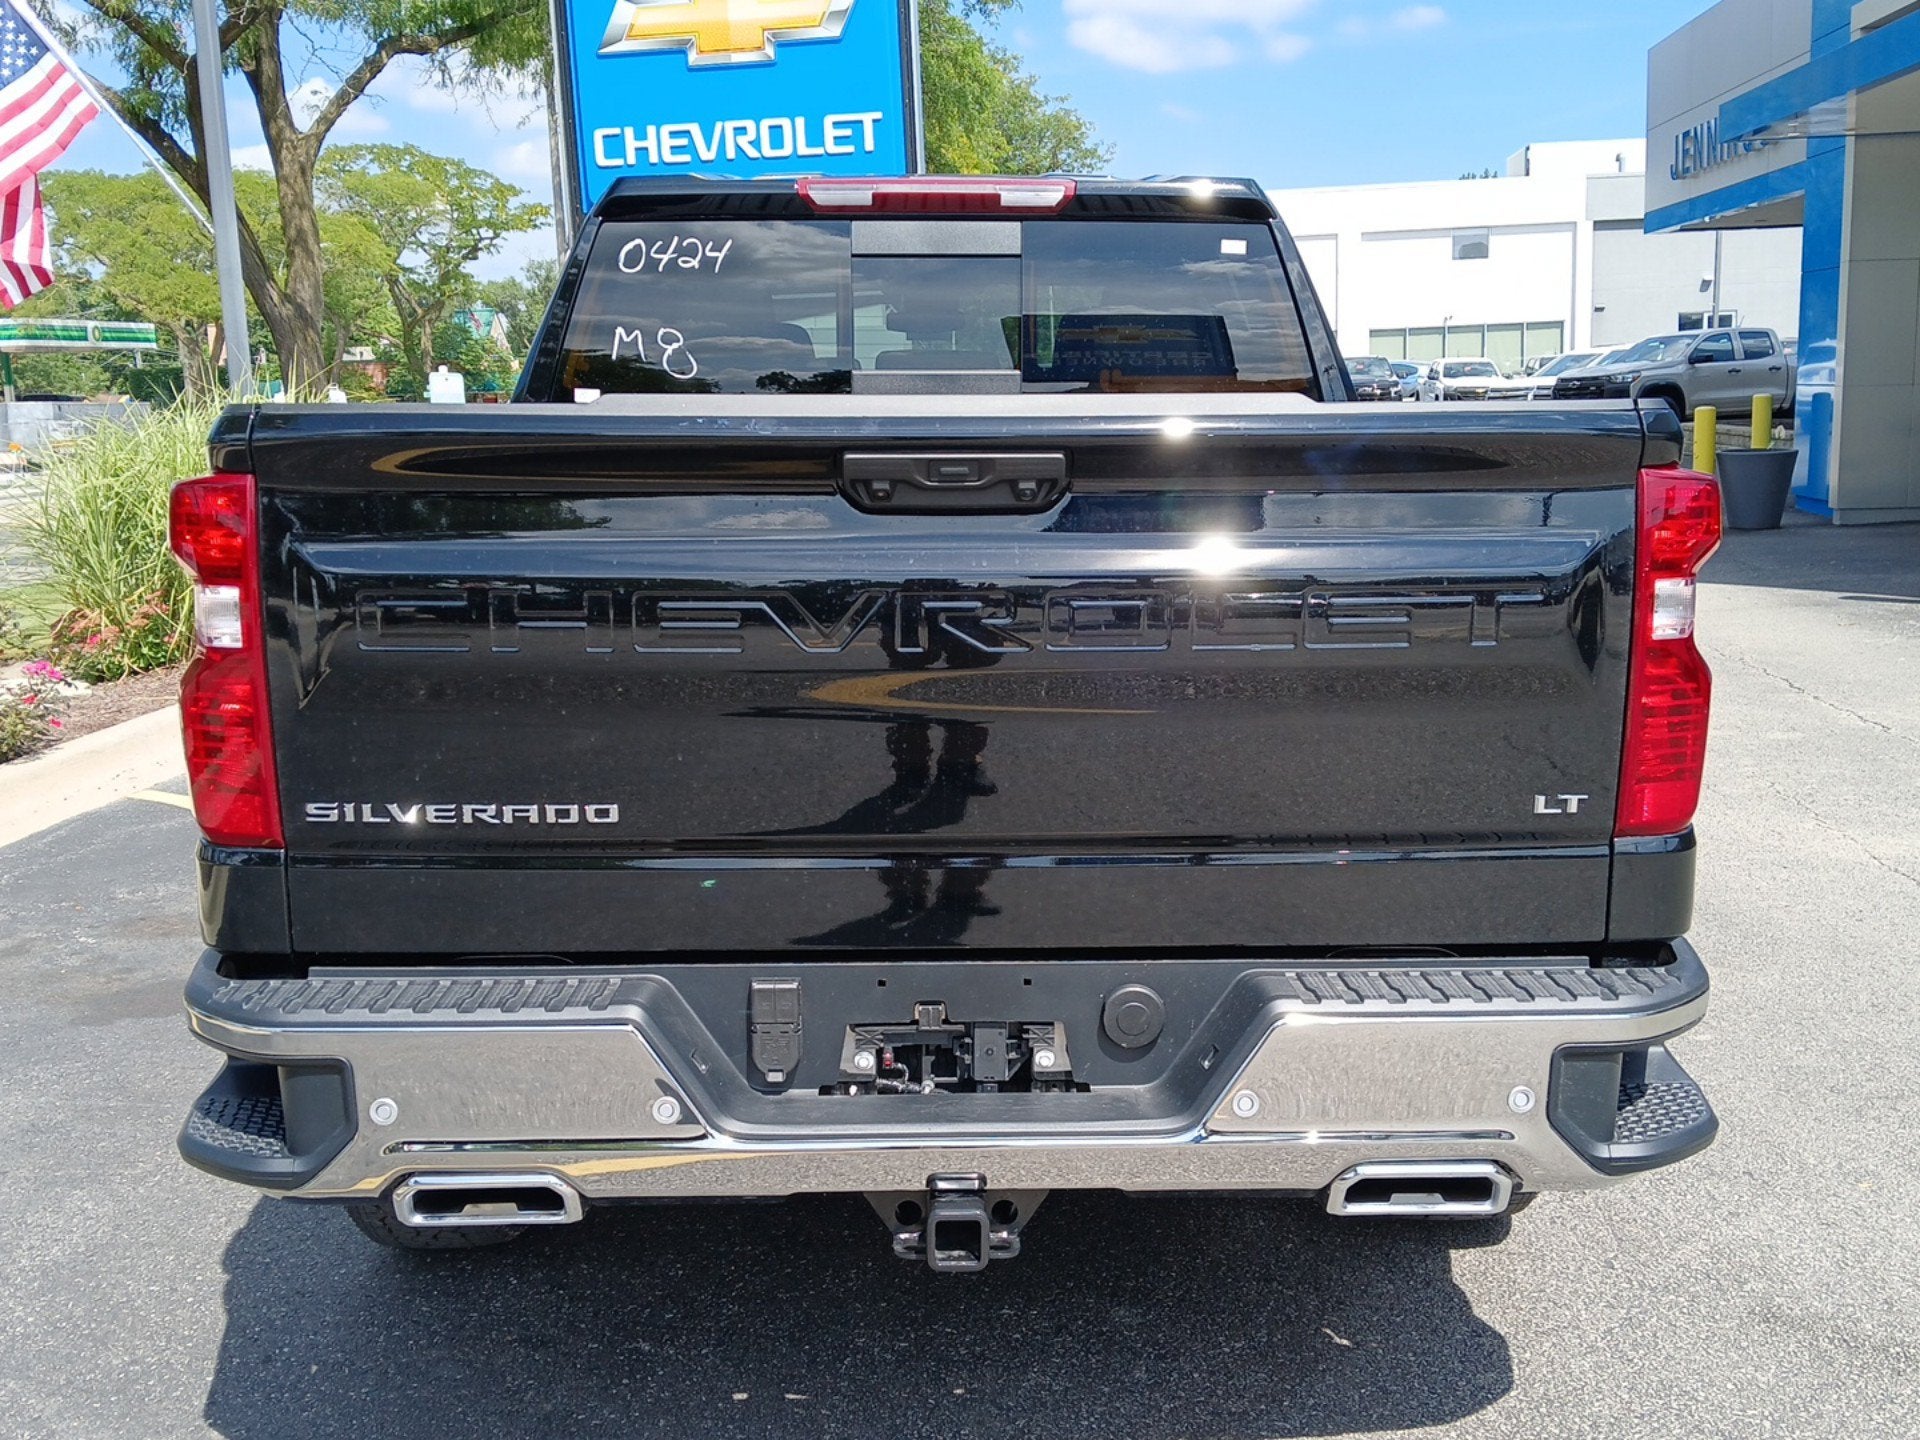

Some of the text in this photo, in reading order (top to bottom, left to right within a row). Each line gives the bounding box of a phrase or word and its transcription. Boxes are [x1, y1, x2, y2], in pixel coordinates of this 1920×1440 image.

[593, 111, 883, 168] CHEVROLET
[1670, 117, 1771, 180] JENN
[618, 235, 733, 274] 0424
[356, 583, 1547, 655] CHEVROLET
[304, 801, 620, 826] SILVERADO
[1533, 793, 1589, 815] LT
